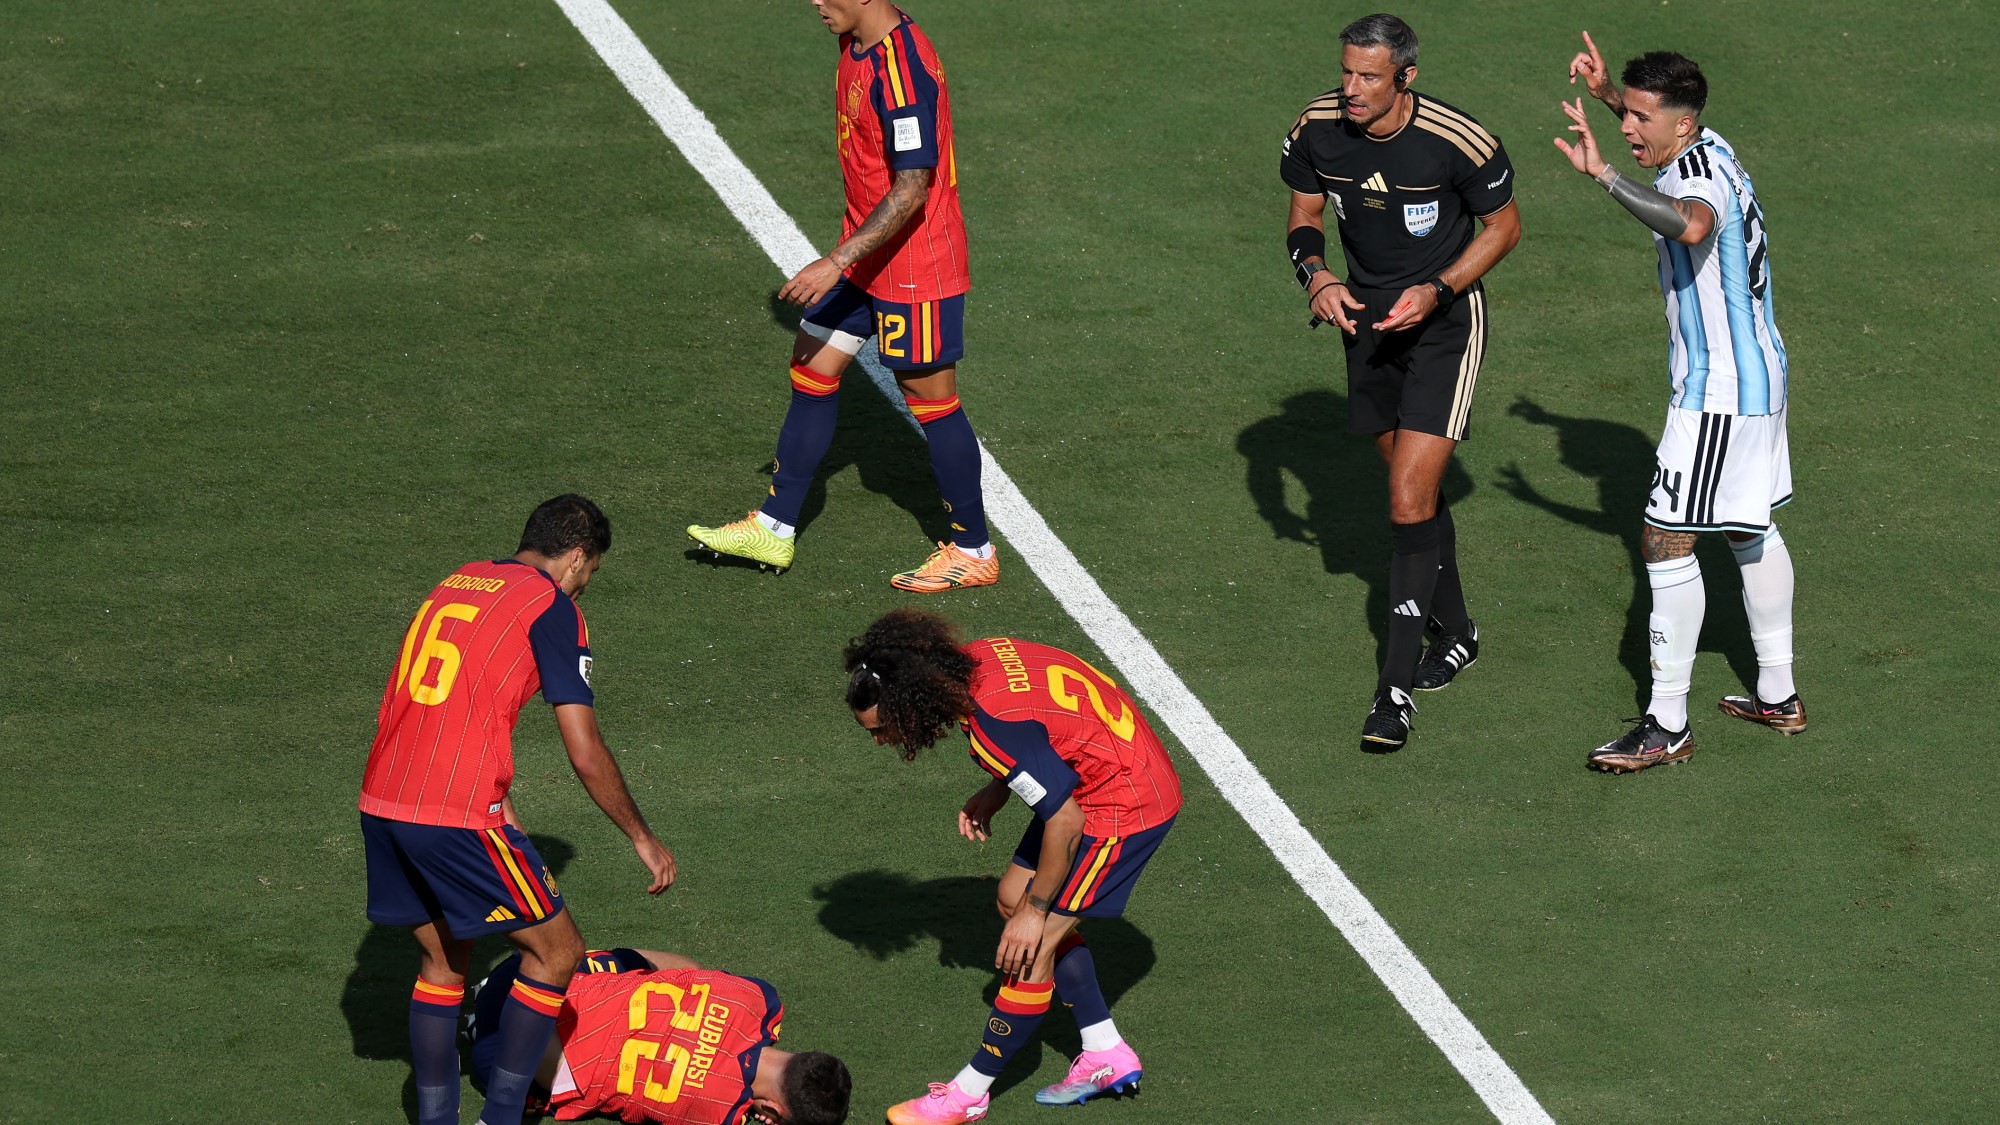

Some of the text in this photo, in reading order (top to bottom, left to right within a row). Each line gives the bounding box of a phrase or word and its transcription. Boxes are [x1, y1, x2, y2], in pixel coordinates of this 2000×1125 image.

[1407, 205, 1435, 216] FIFA
[1408, 215, 1436, 226] REFEREE
[877, 311, 906, 358] 12
[1649, 462, 1682, 513] 24
[395, 600, 480, 706] 16
[1650, 628, 1668, 646] FA
[1046, 659, 1136, 743] 2
[616, 981, 711, 1104] 22
[684, 1002, 730, 1089] CUBARSI
